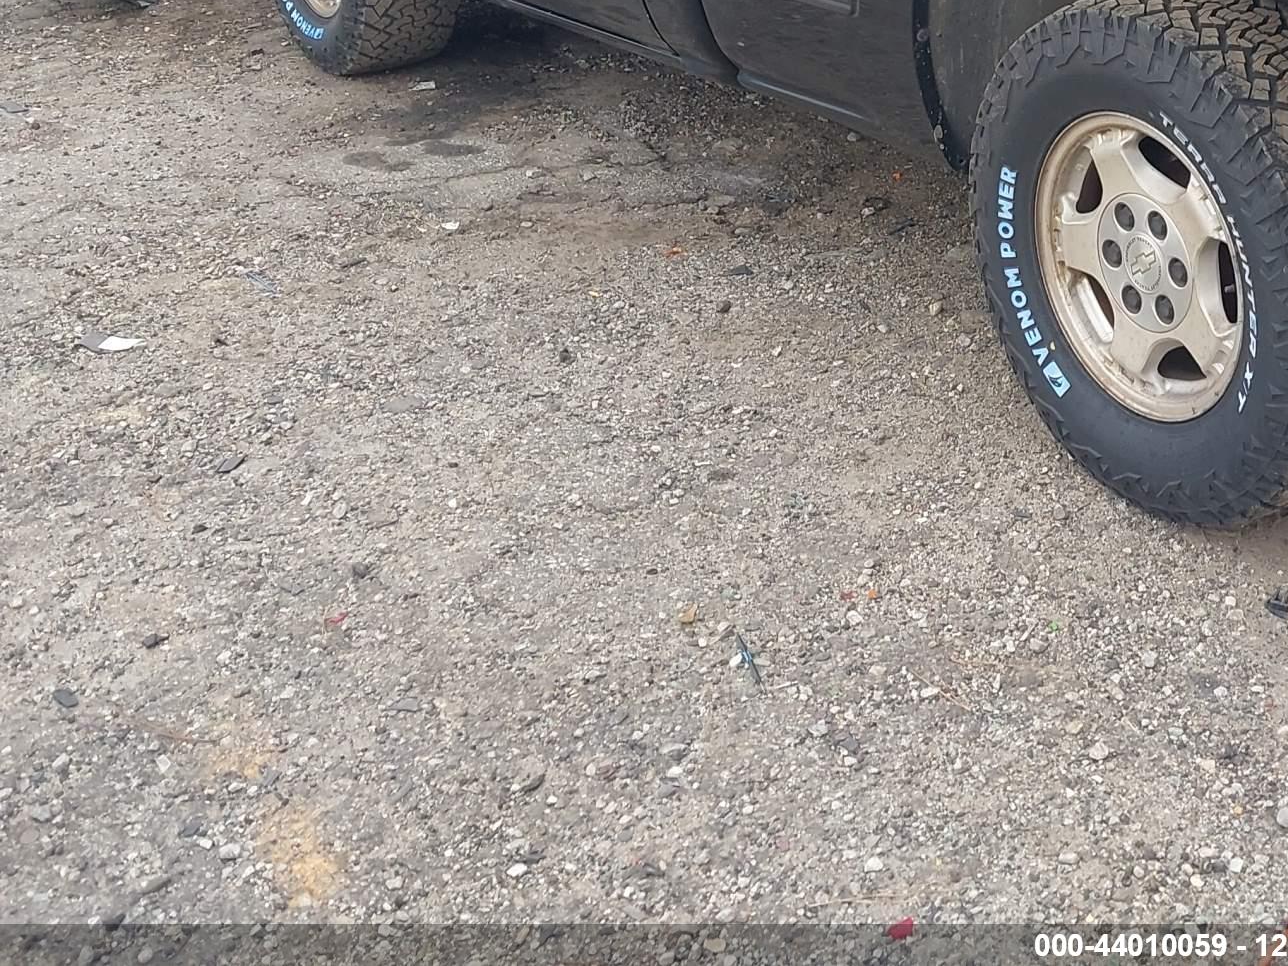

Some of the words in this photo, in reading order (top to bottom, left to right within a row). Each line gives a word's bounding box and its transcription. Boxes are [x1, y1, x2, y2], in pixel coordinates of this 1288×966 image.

[291, 10, 318, 39] VENOM
[998, 166, 1018, 258] POWER
[1160, 111, 1227, 204] TERRA
[1227, 215, 1258, 359] HUNTER
[1004, 268, 1049, 366] VENOM
